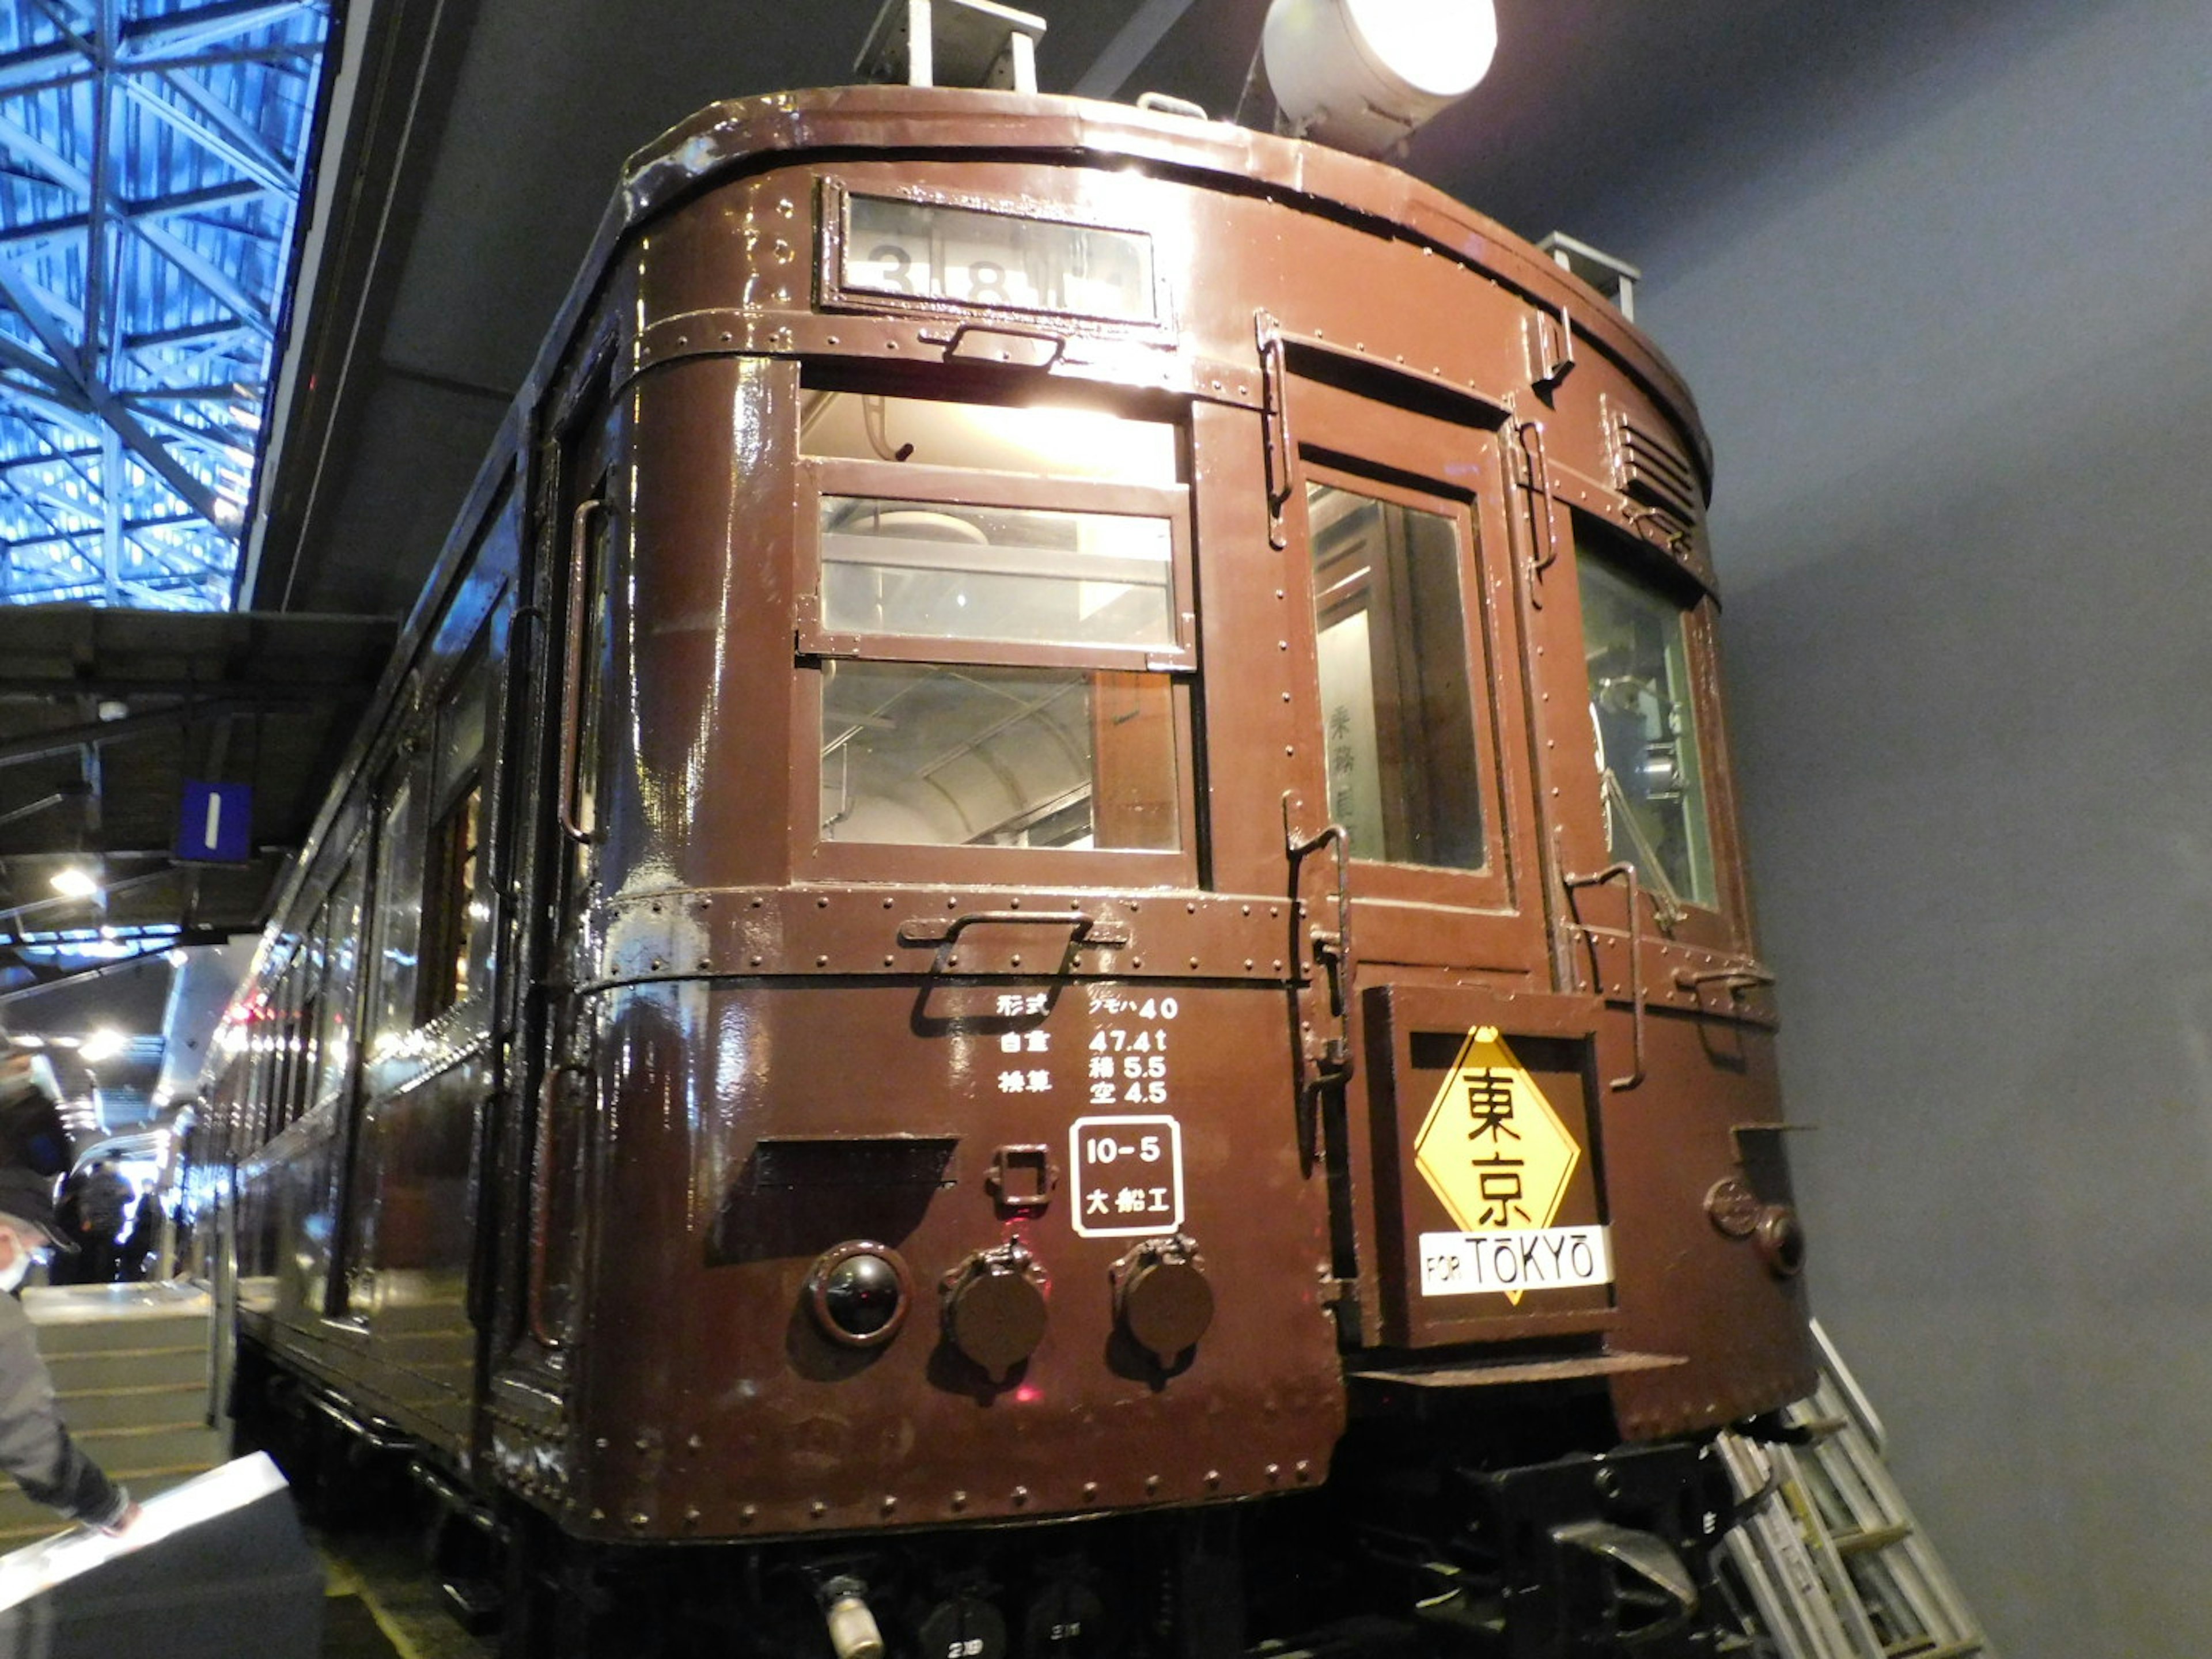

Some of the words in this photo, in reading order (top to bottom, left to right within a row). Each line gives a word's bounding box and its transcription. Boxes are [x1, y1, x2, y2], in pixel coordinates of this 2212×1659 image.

[997, 993, 1050, 1017] 形式
[1086, 1136, 1160, 1164] 10-5
[1464, 1067, 1532, 1226] 東京
[1426, 1256, 1461, 1282] FOR
